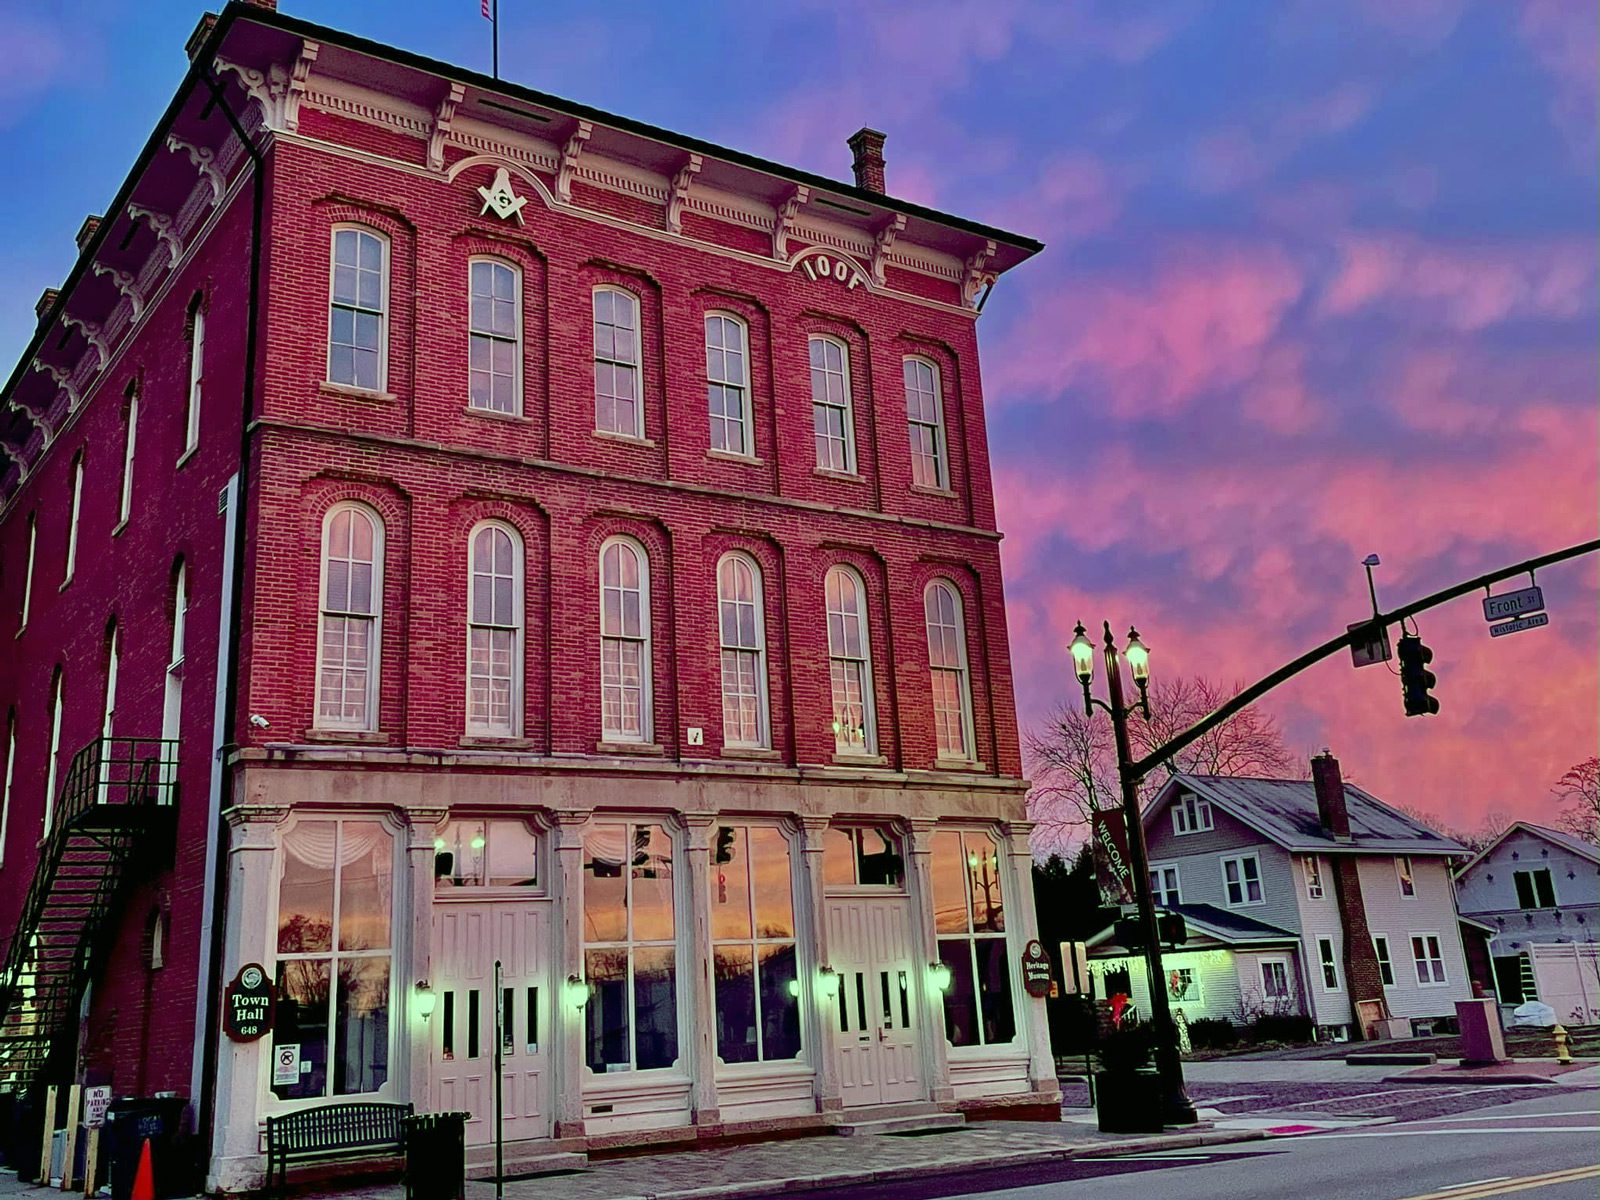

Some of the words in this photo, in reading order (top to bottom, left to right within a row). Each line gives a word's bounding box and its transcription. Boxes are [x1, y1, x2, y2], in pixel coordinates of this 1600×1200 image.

[803, 255, 864, 290] IOOF
[1490, 596, 1523, 615] Front
[1494, 622, 1523, 634] Historic
[1527, 617, 1545, 626] Area
[1098, 820, 1130, 879] WELCOME
[1026, 961, 1049, 971] Heritage
[1028, 972, 1050, 981] Museum
[232, 994, 269, 1008] Town
[236, 1008, 264, 1021] Hall
[241, 1026, 258, 1035] 648
[93, 1089, 104, 1098] NO
[87, 1097, 112, 1107] PARKING
